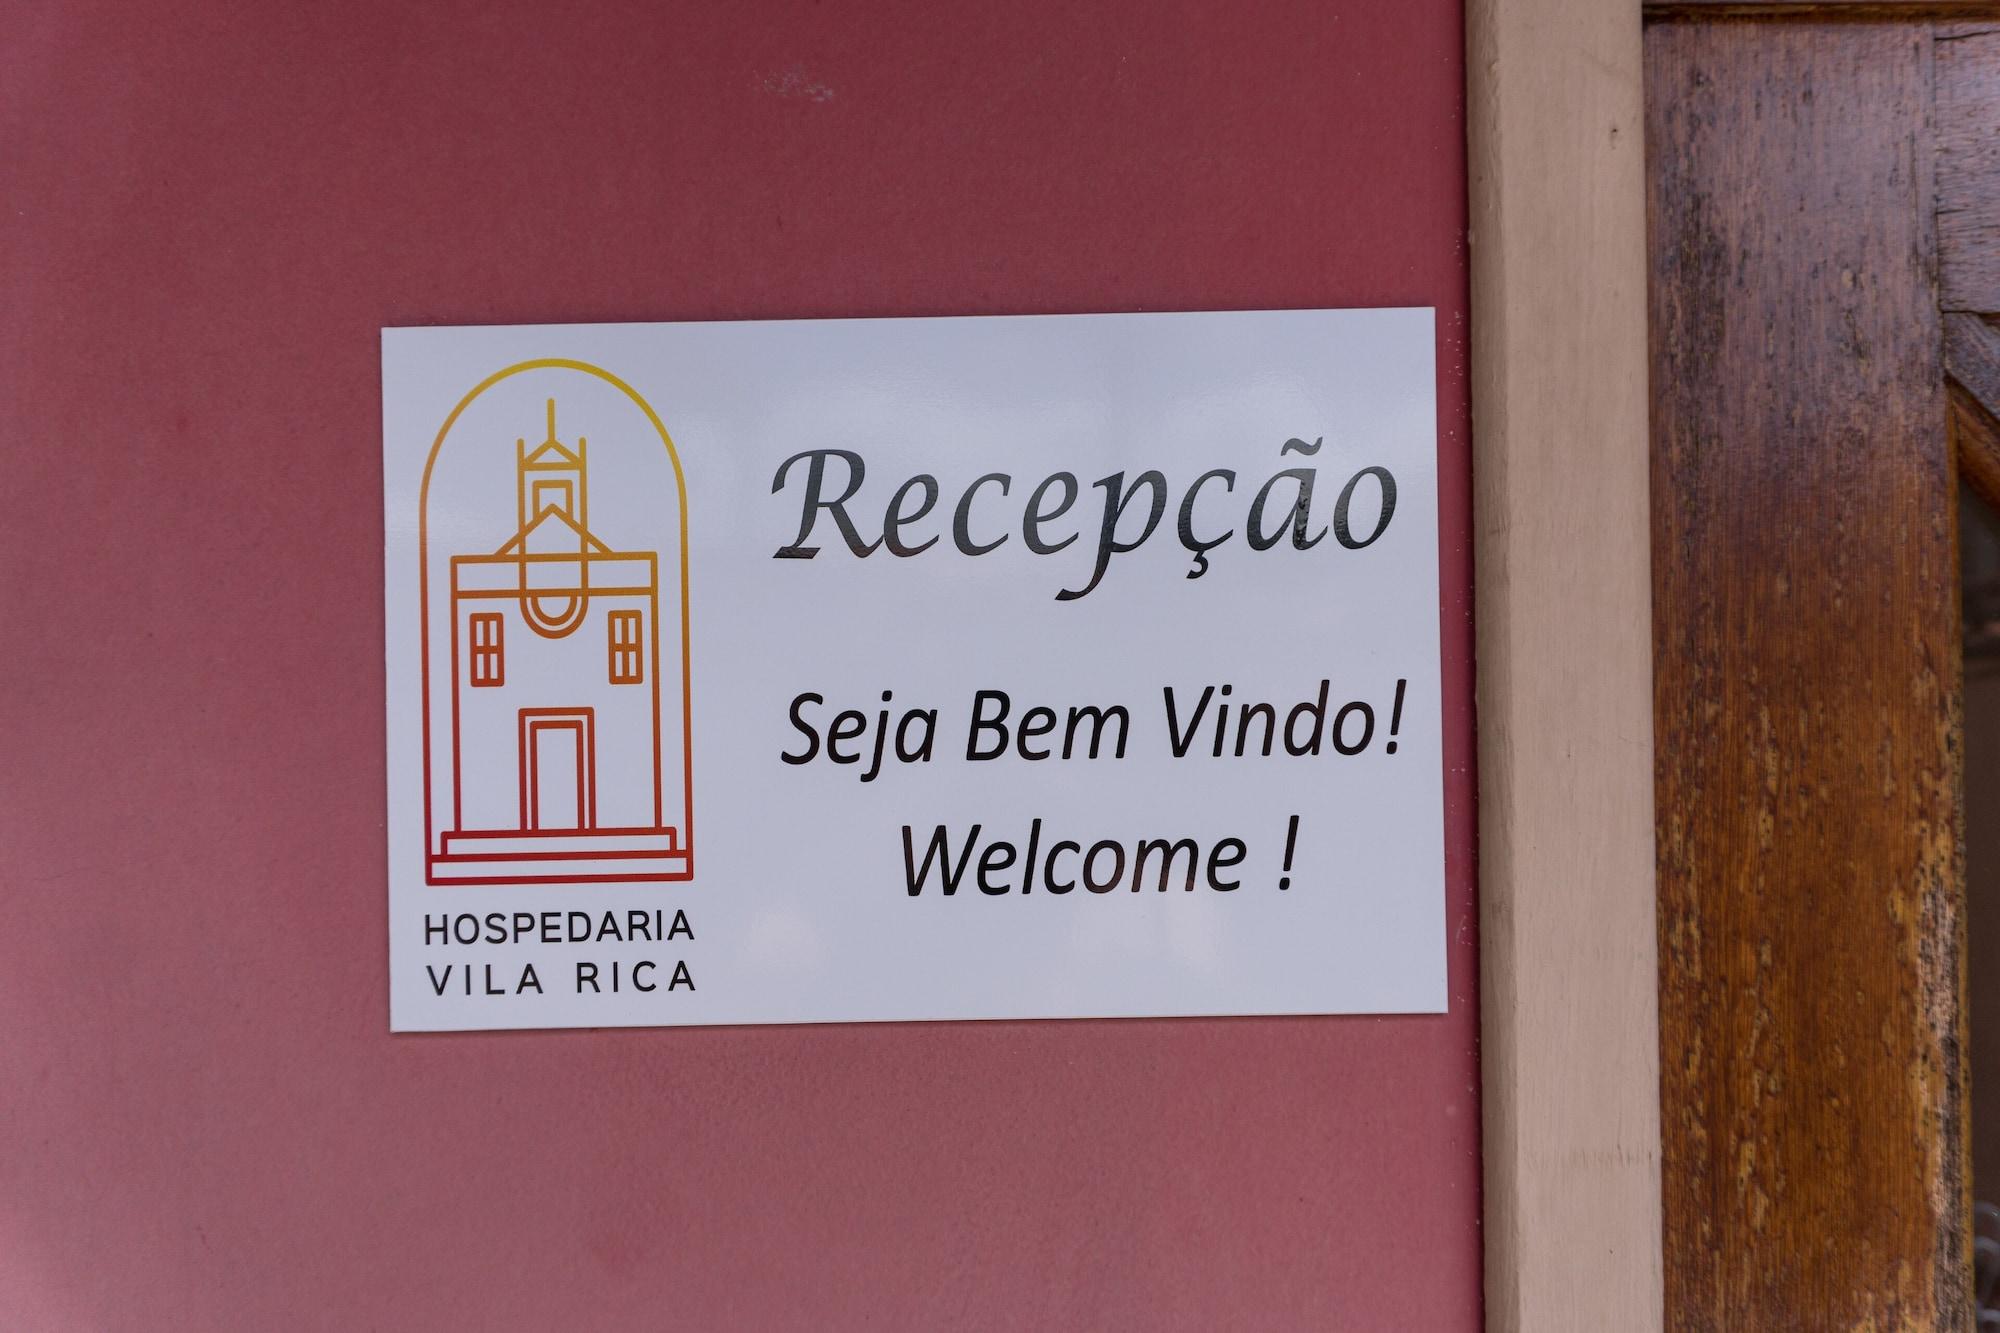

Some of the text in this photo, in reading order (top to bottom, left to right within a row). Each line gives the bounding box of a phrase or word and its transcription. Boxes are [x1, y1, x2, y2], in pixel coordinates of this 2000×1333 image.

[771, 436, 1398, 602] Recepção
[780, 678, 1408, 783] Seja Bem Vindo!
[901, 814, 1300, 897] Welcome !
[424, 909, 695, 946] HOSPEDARIA
[425, 960, 696, 996] VILA RICA
